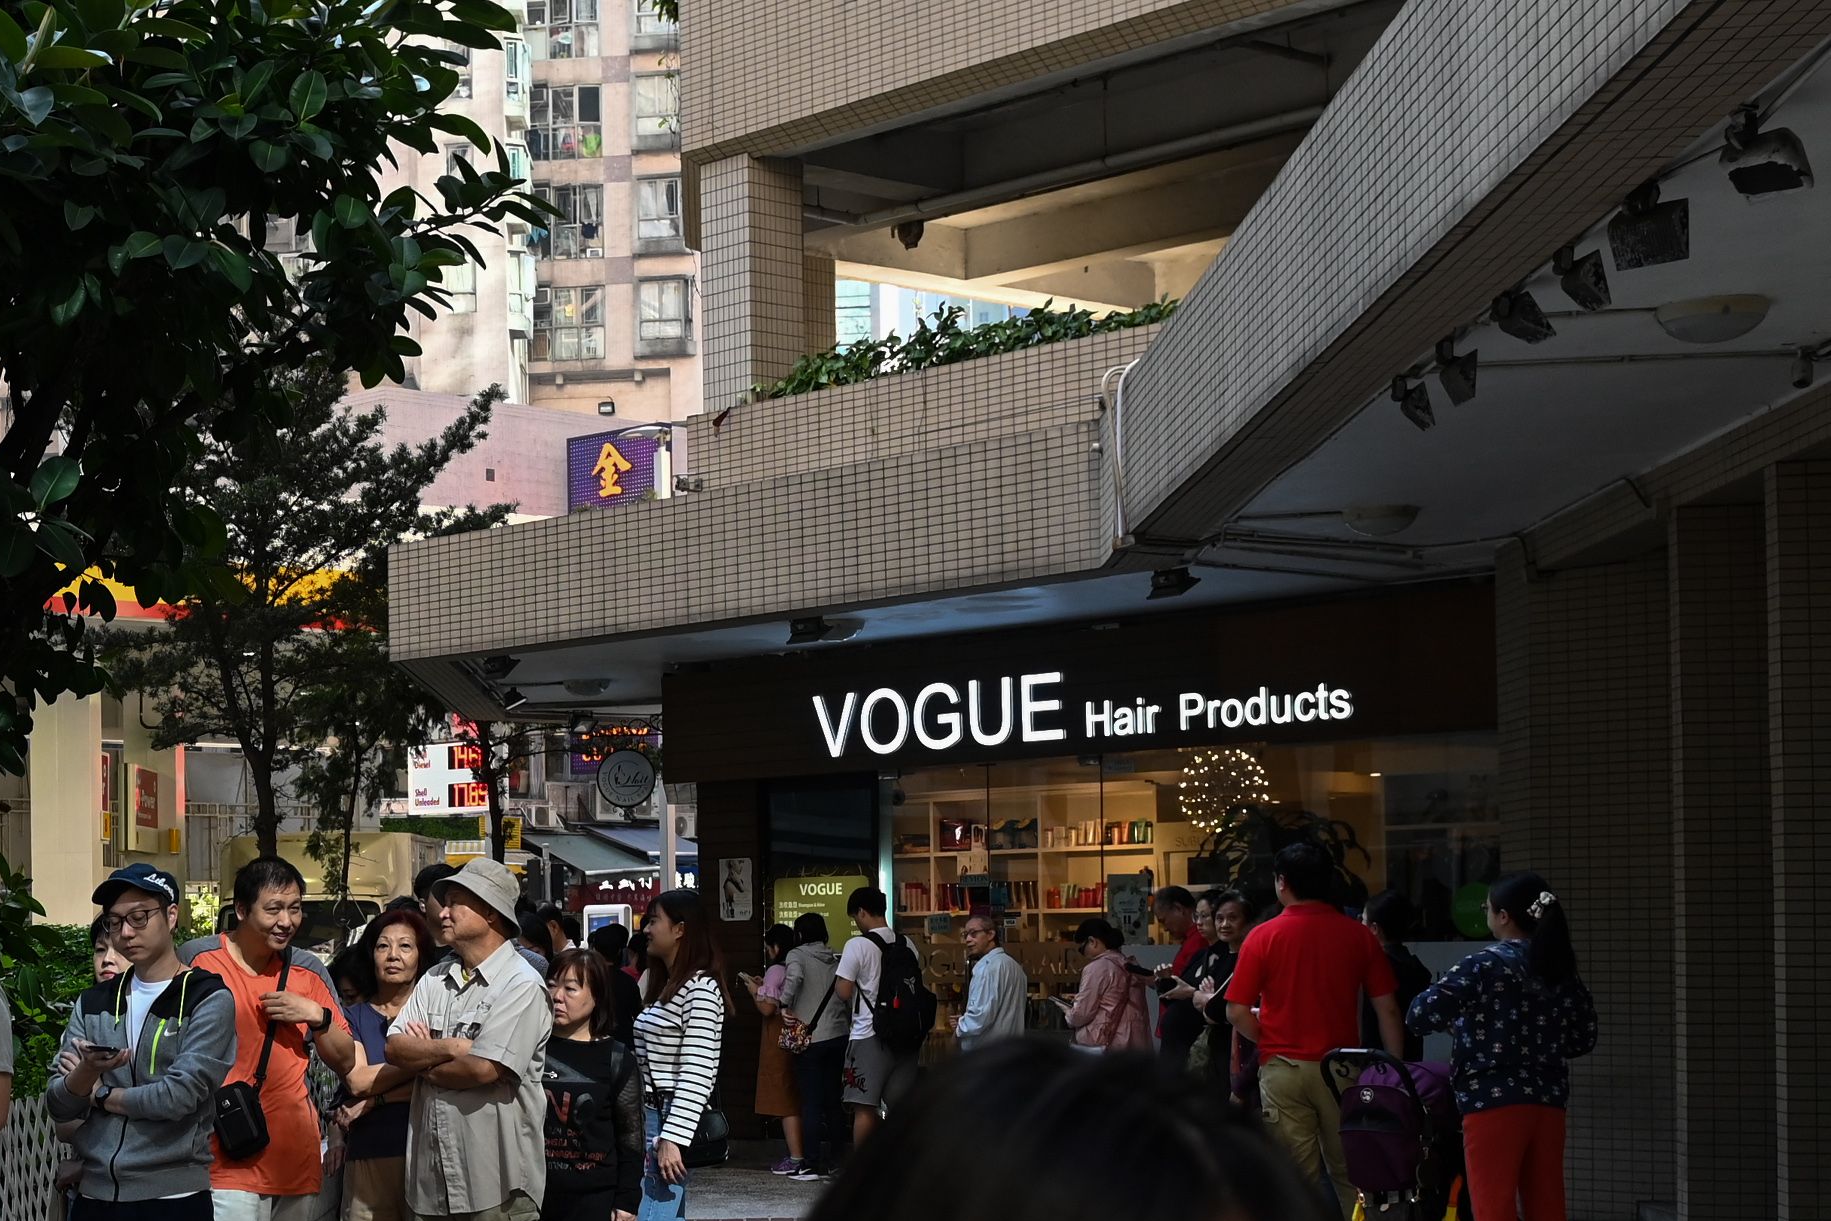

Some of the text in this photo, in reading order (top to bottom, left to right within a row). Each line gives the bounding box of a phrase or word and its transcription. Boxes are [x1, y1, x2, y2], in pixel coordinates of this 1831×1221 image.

[592, 442, 633, 498] 金
[812, 671, 1354, 757] VOGUE Hair Products
[799, 882, 843, 896] VOGUE
